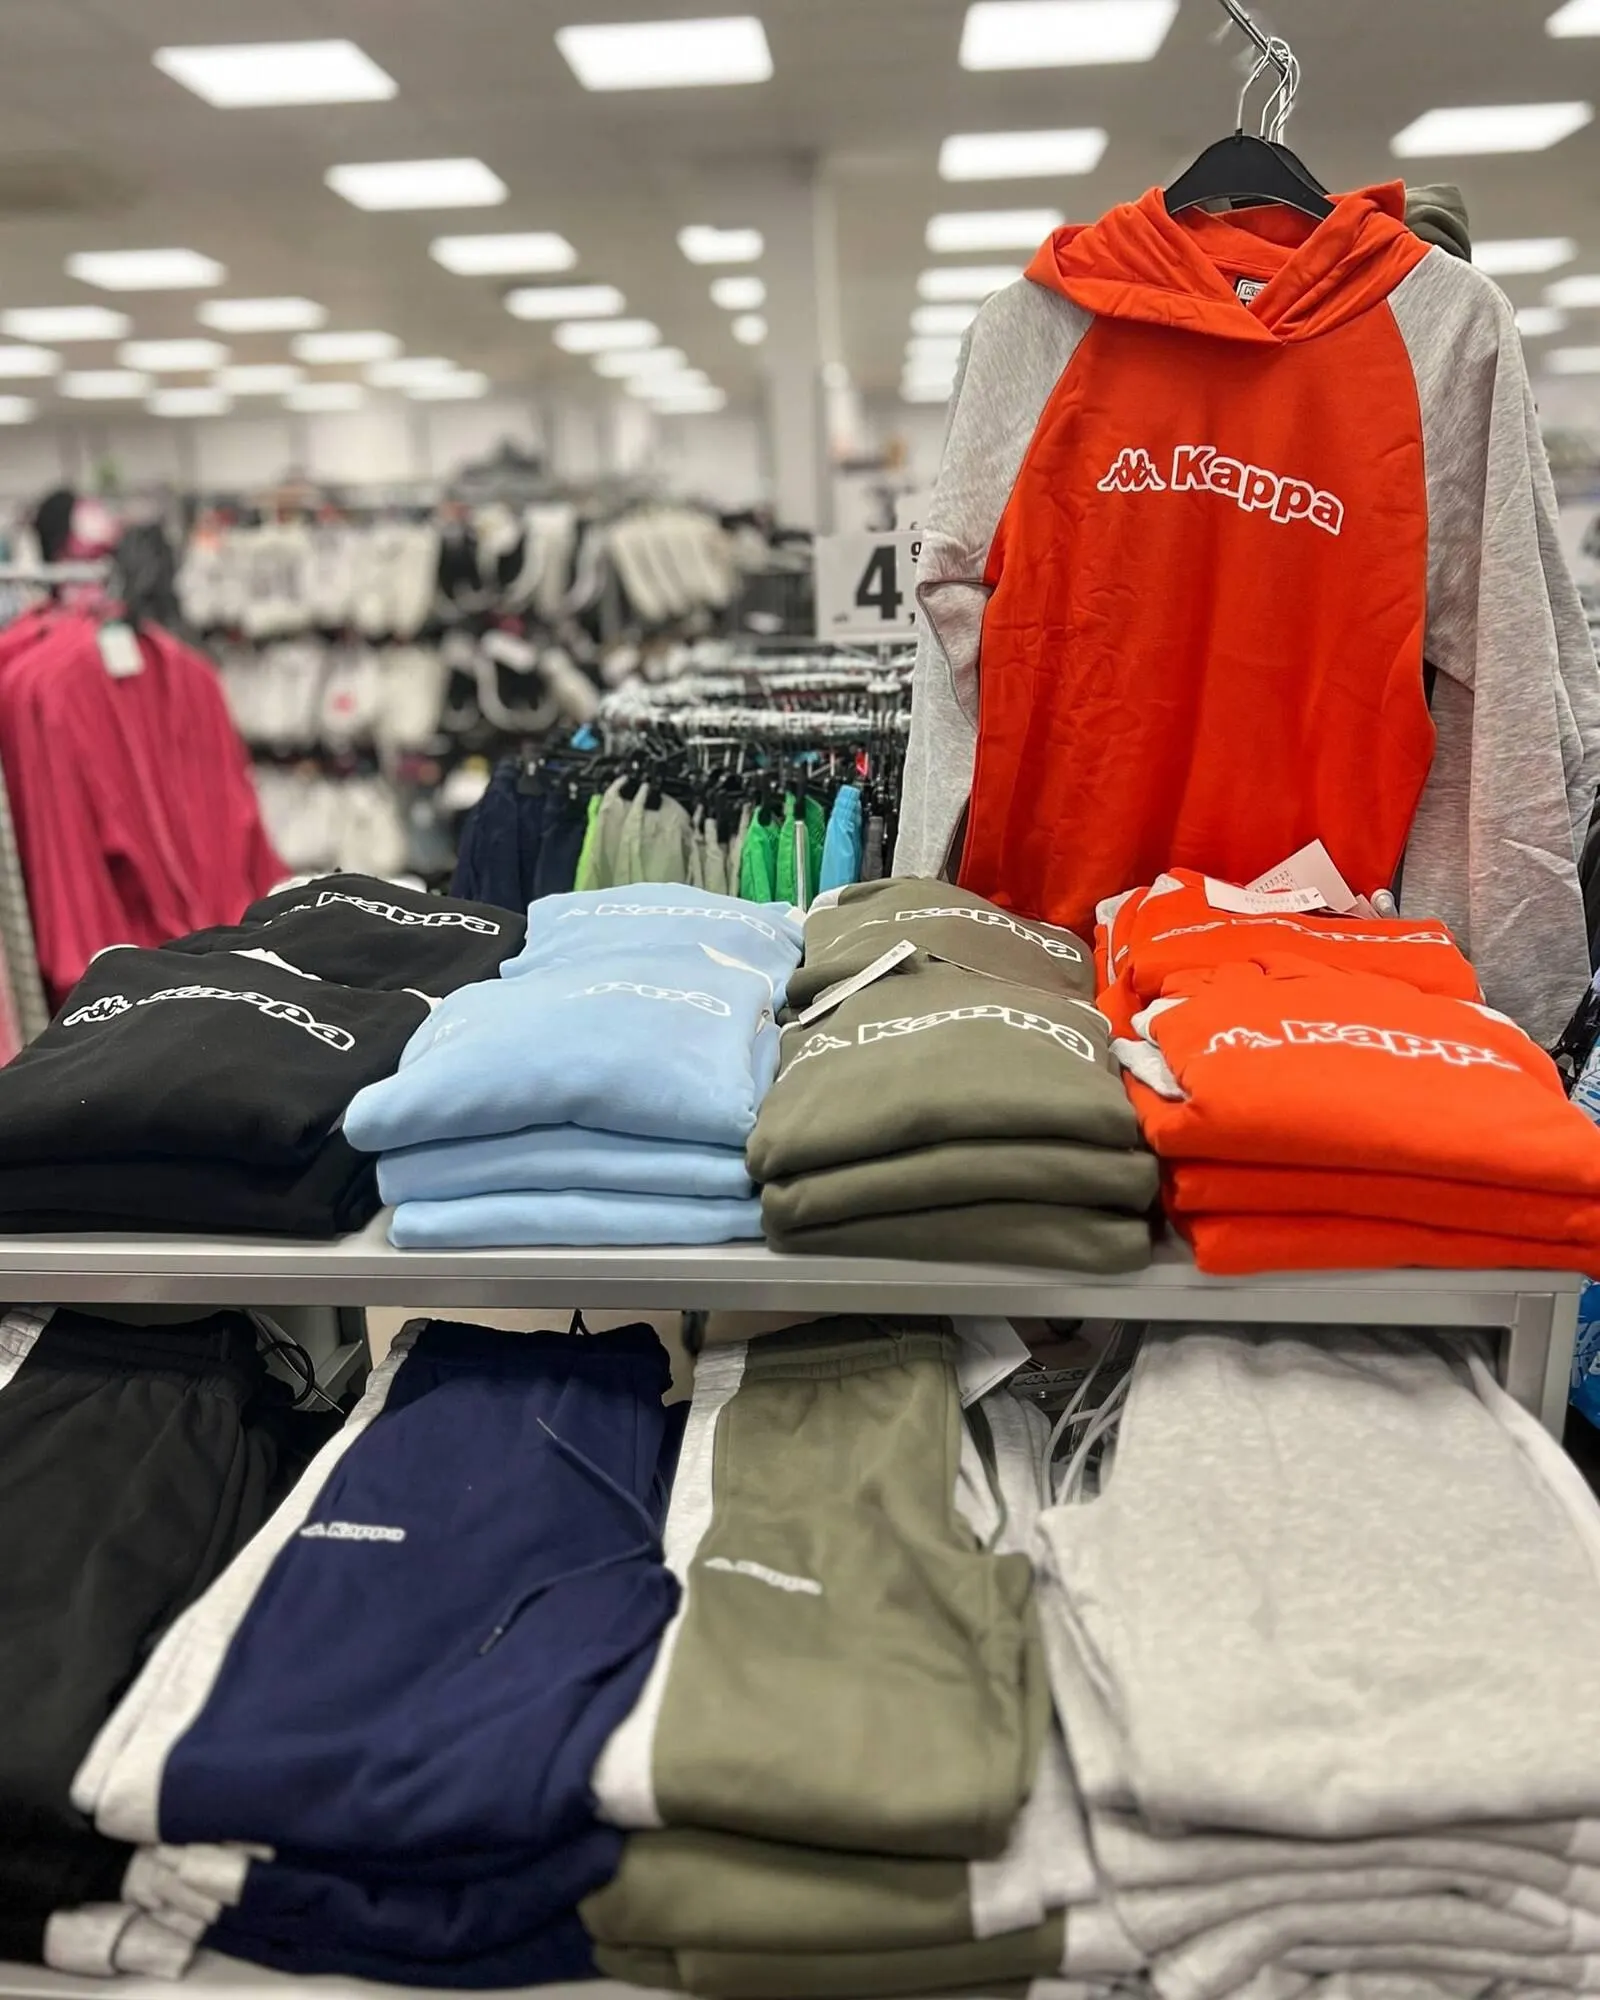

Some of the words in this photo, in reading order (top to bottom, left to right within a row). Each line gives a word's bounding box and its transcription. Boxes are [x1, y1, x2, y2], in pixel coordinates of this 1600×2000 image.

[1170, 445, 1344, 535] Kappa
[895, 907, 1082, 962] Kappa
[858, 1005, 1095, 1062] Kappa
